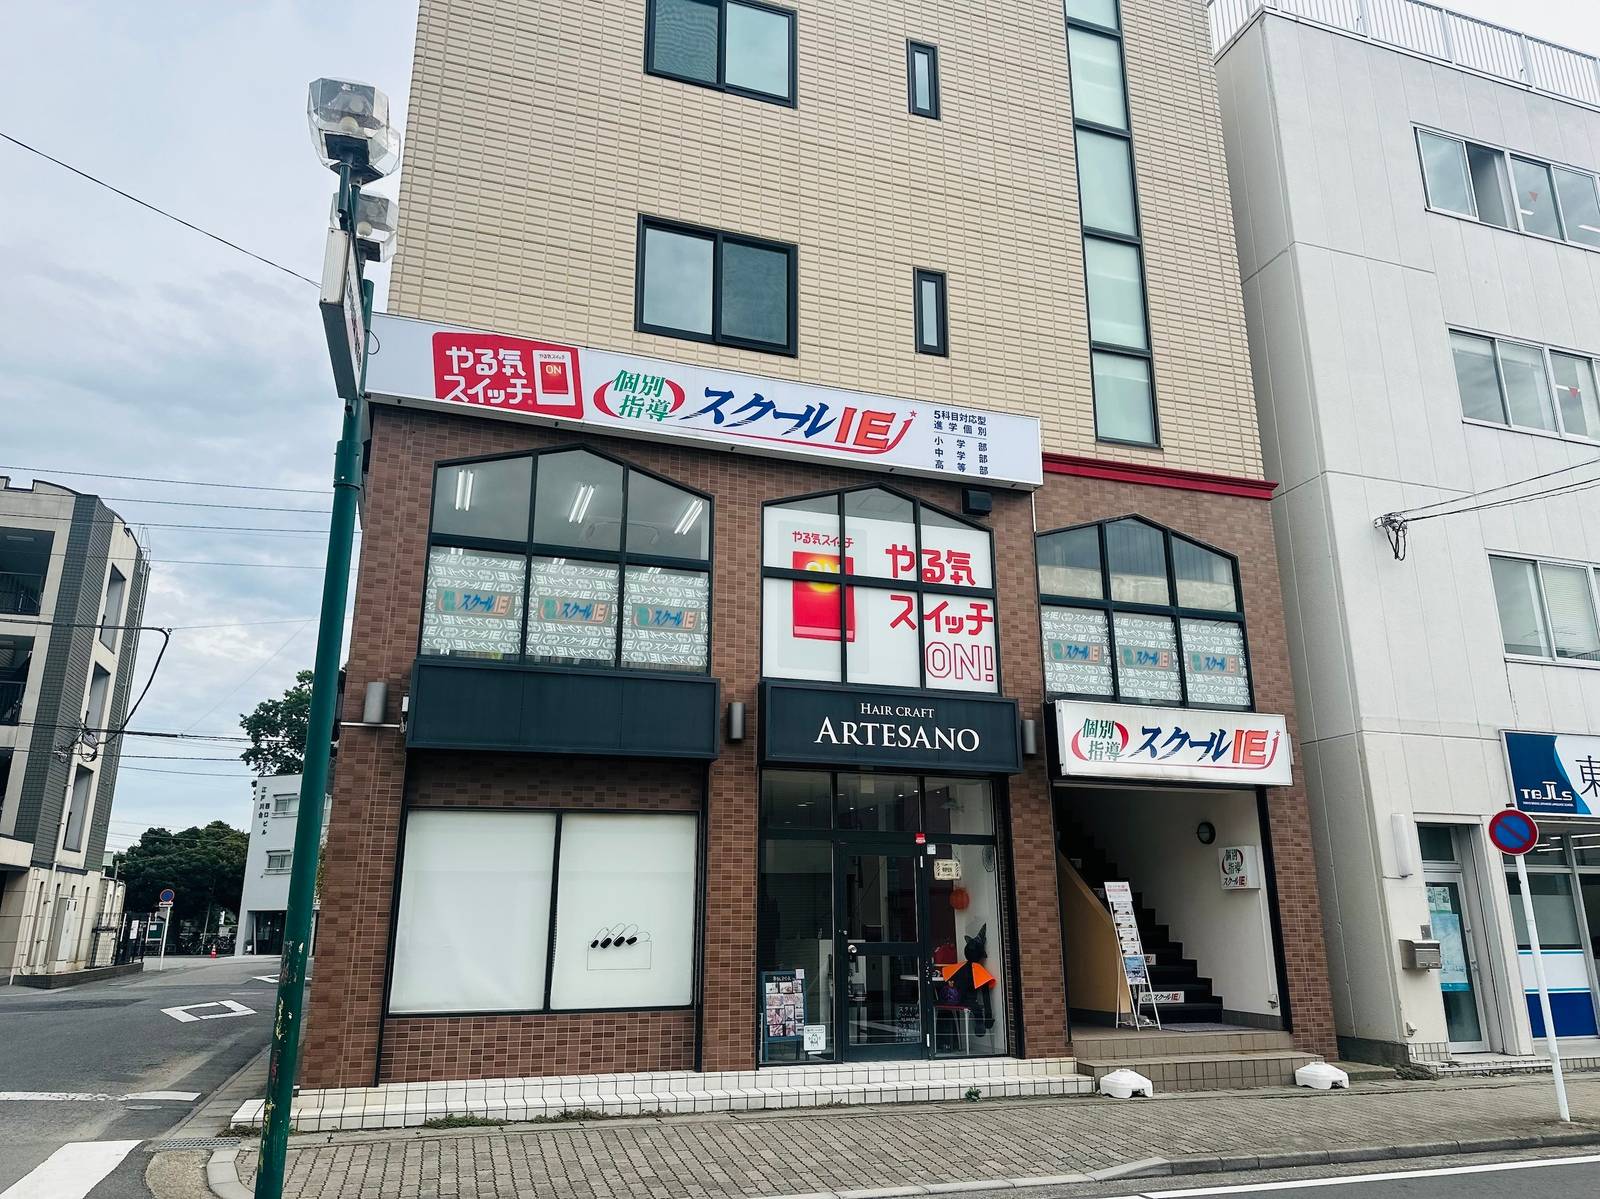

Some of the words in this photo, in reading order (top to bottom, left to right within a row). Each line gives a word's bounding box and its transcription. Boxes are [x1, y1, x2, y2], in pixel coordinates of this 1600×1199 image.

[445, 346, 527, 377] やる気
[545, 364, 562, 375] ON
[443, 375, 533, 405] スイッチ
[613, 369, 666, 398] 個別
[618, 394, 672, 422] 指導
[679, 386, 897, 450] スクールIE
[934, 410, 987, 426] 5科目対応型
[934, 420, 987, 437] 進学個別
[934, 436, 988, 452] 小学部
[934, 447, 988, 464] 中学部
[935, 459, 989, 476] 高等部
[885, 543, 976, 585] やる気
[889, 594, 994, 635] スイッチ
[926, 641, 994, 682] ON!
[860, 702, 893, 716] HAIR
[1082, 718, 1116, 740] 個別
[1088, 740, 1121, 762] 指導
[1127, 725, 1269, 766] スクールIE
[1575, 755, 1600, 798] 東
